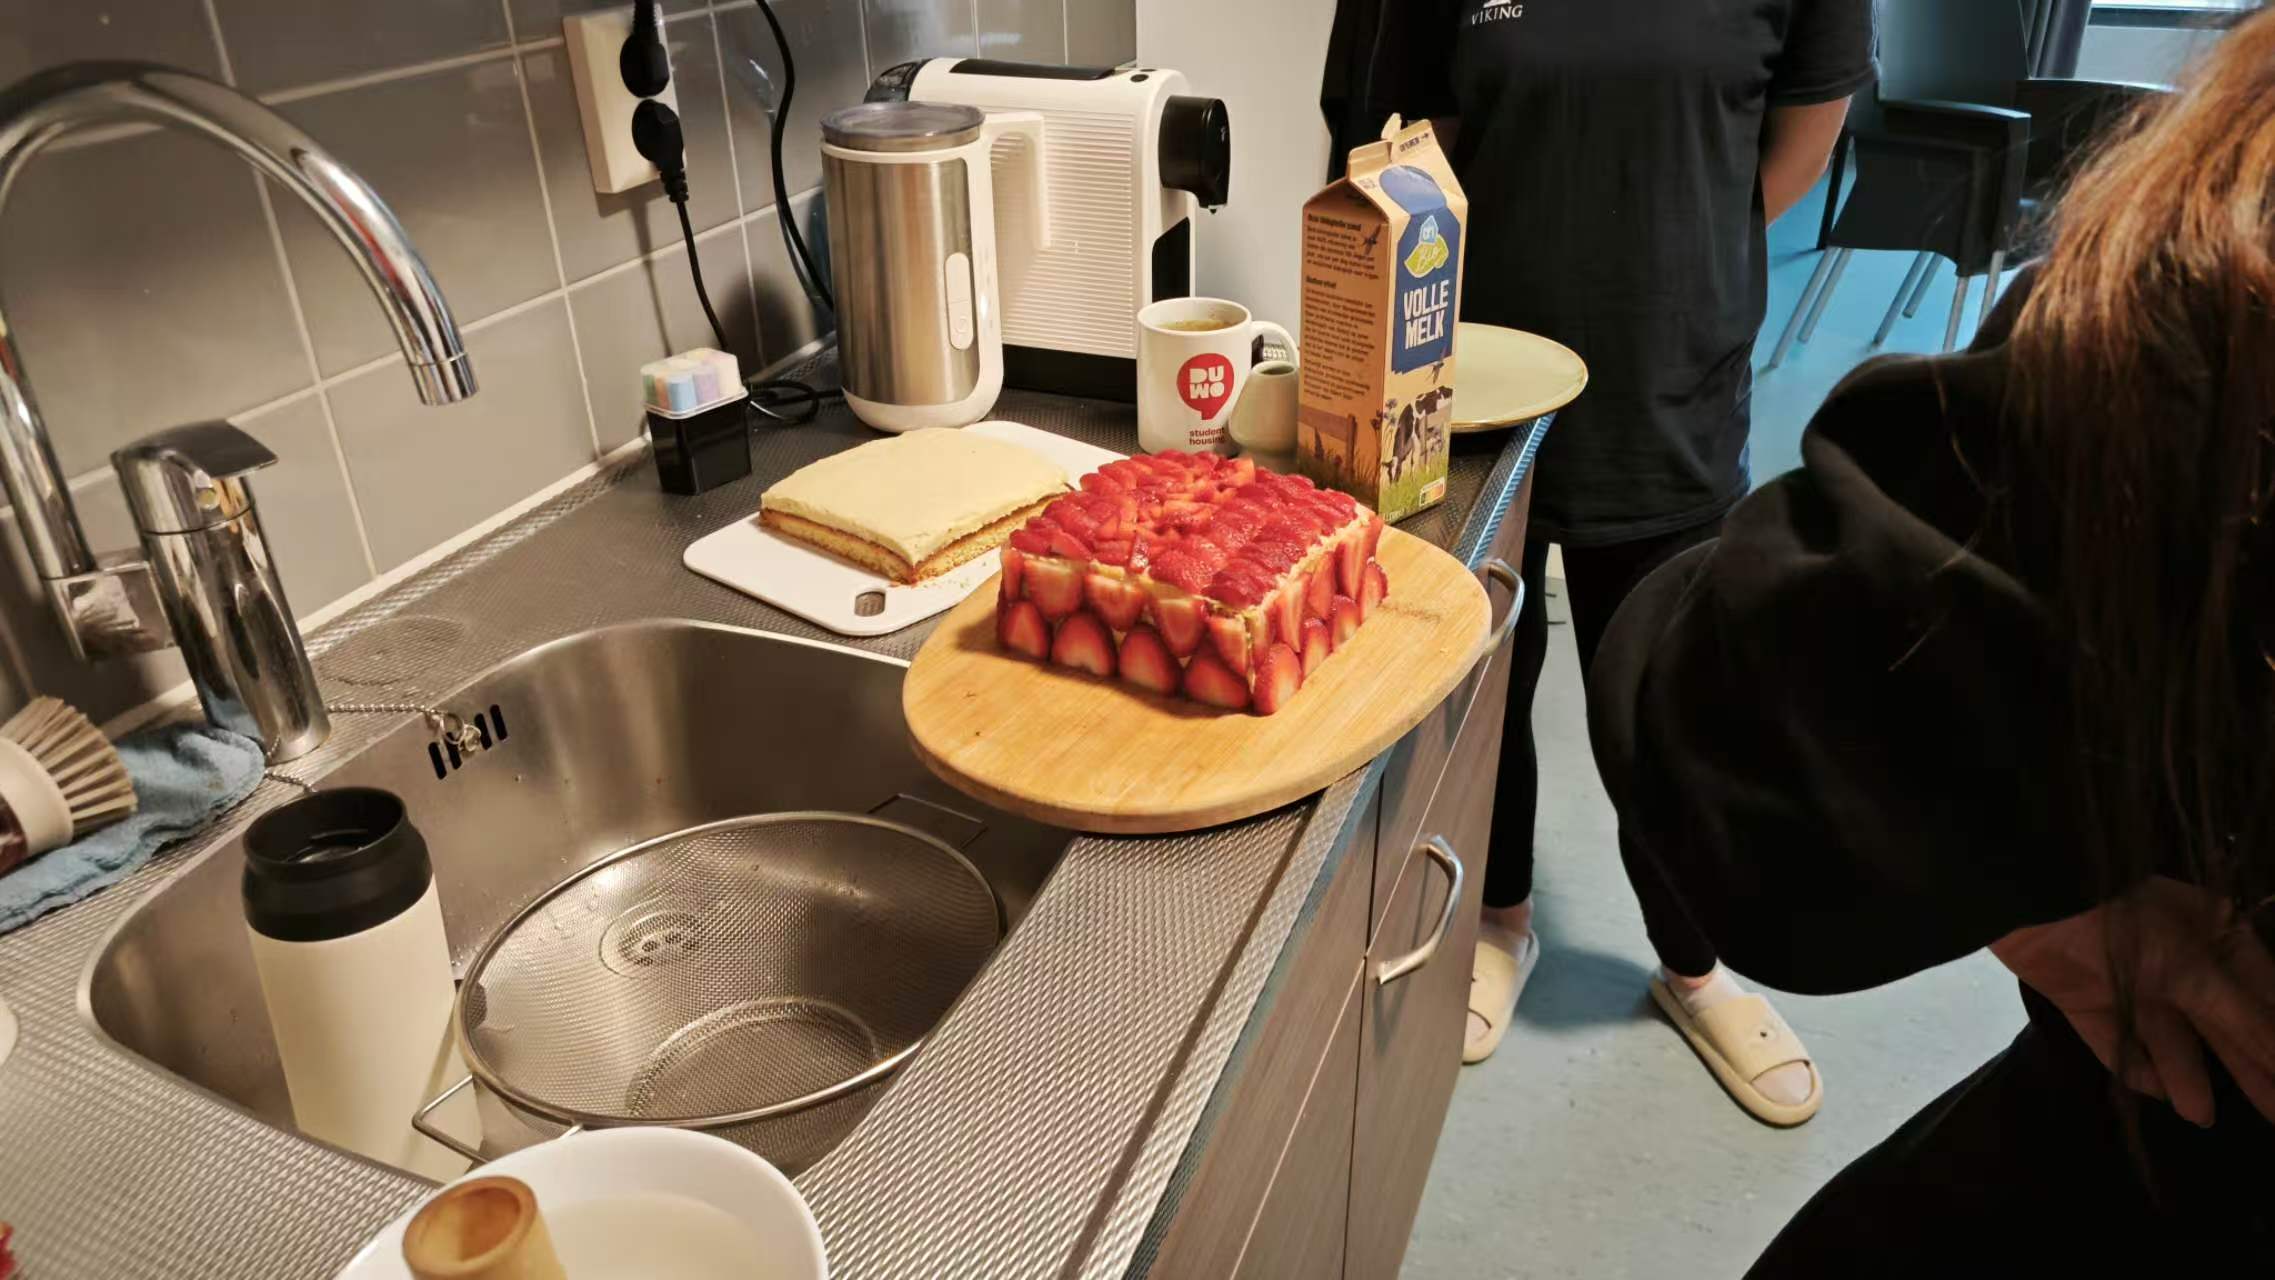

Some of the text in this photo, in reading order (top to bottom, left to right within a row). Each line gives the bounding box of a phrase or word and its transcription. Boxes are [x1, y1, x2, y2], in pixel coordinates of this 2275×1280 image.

[1471, 4, 1523, 25] VIKING
[1404, 279, 1449, 320] VOLLE
[1405, 311, 1444, 349] MELK
[1189, 427, 1225, 436] student
